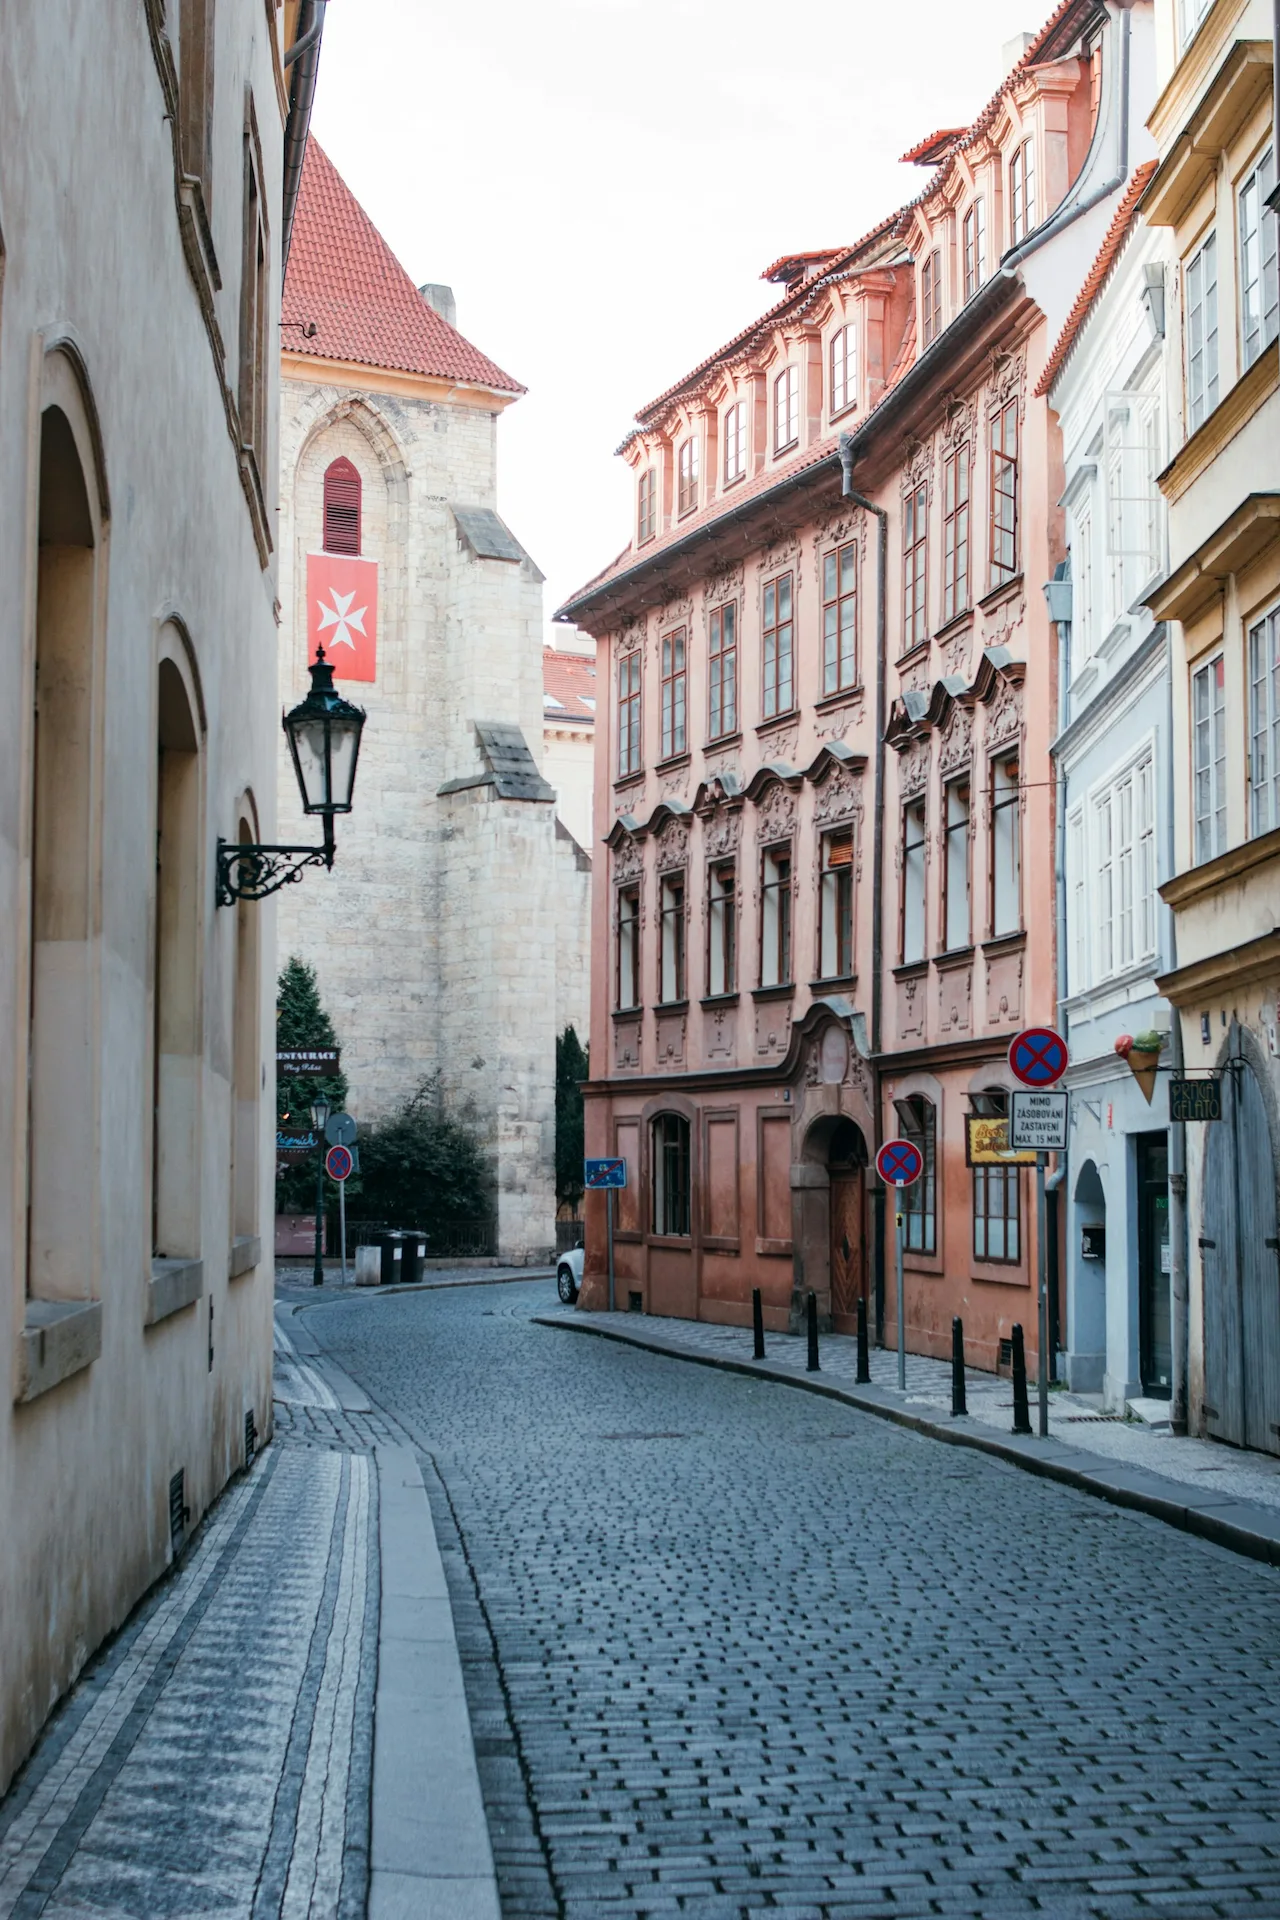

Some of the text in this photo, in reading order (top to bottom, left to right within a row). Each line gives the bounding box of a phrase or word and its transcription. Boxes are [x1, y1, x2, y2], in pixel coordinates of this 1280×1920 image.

[1172, 1081, 1214, 1100] PRAGA
[1029, 1097, 1051, 1106] MIMO
[1016, 1106, 1064, 1119] ZÁSOBOVÁNÍ
[1172, 1098, 1219, 1119] GELATO
[975, 1124, 1004, 1139] Beer
[1020, 1121, 1059, 1131] ZASTAVENÍ
[1036, 1135, 1045, 1144] 15
